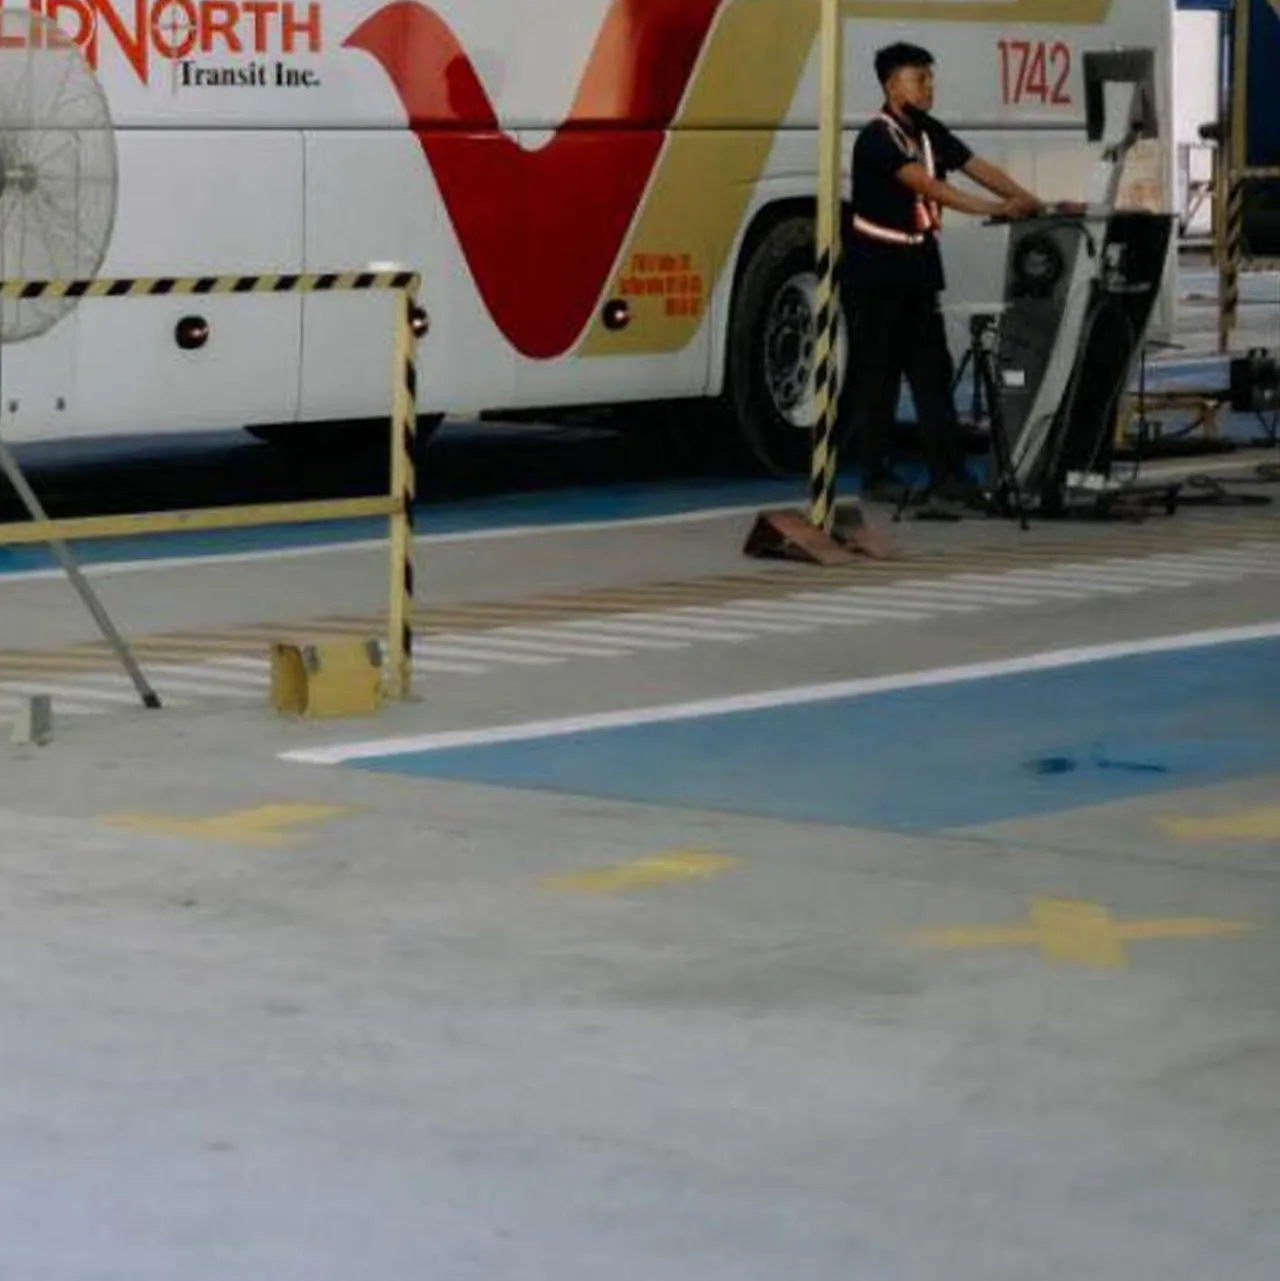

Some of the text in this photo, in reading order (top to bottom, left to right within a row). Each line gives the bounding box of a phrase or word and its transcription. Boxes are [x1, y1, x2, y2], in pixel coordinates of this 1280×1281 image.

[180, 61, 321, 87] Transit Inc.
[997, 40, 1072, 105] 1742
